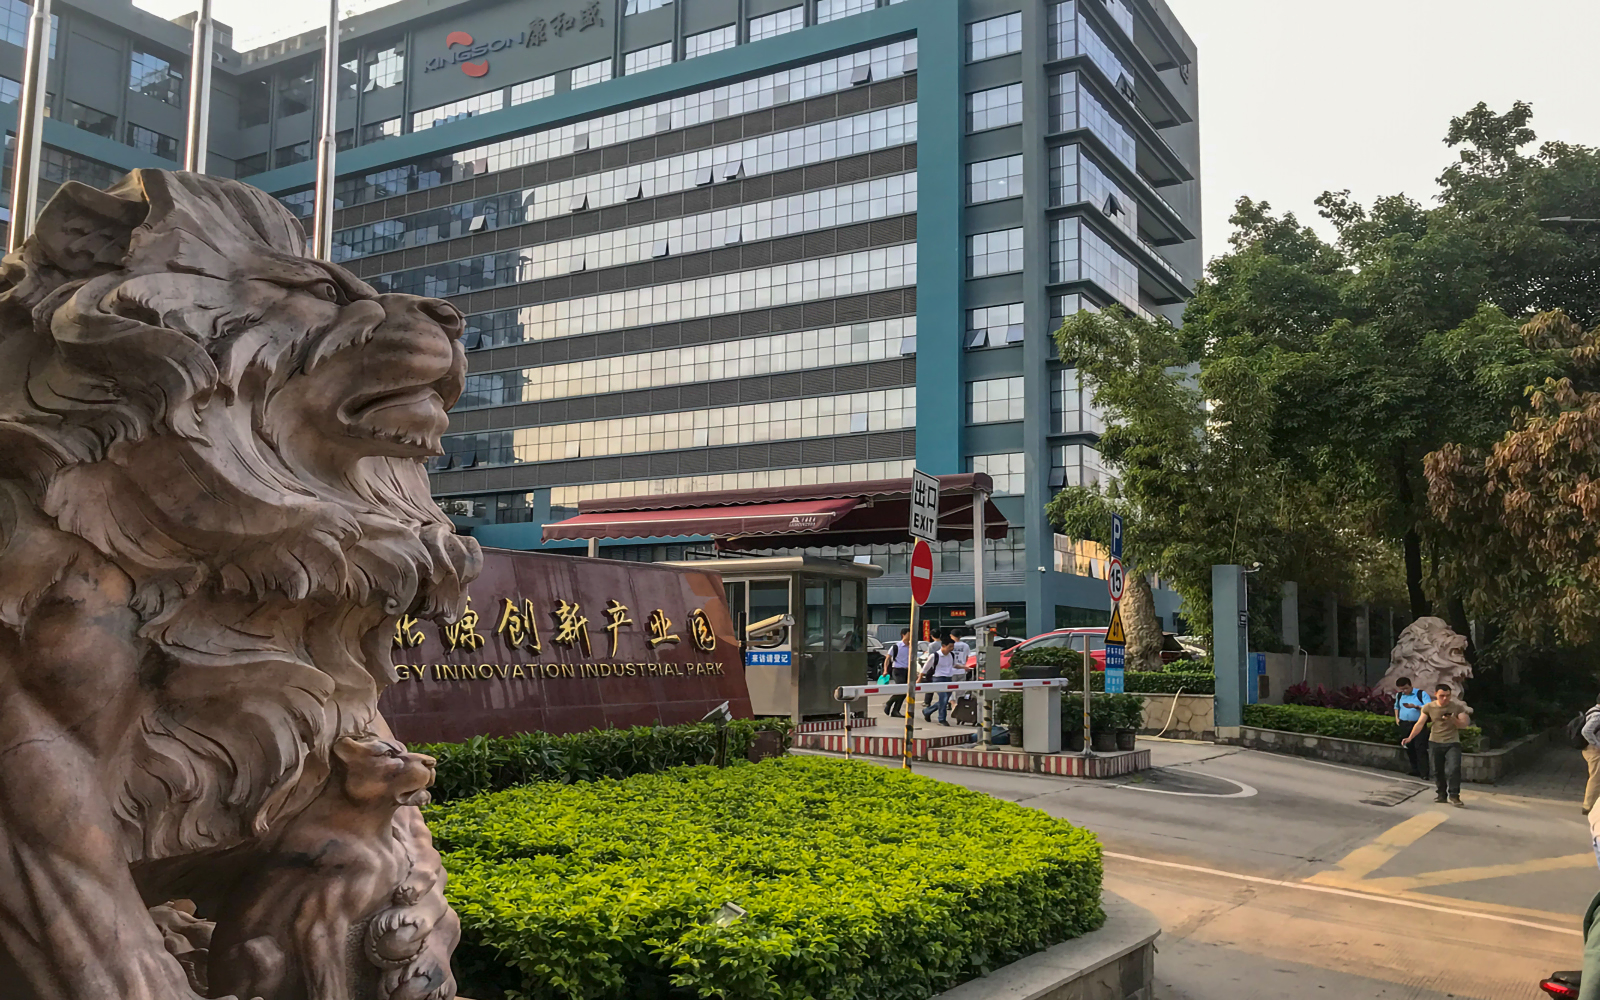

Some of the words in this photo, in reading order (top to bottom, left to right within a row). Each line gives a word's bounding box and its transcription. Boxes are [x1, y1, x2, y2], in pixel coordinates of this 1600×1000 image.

[424, 31, 525, 73] KINGSON
[914, 479, 937, 511] 出口
[913, 512, 935, 534] EXIT
[1113, 517, 1121, 552] P
[1110, 568, 1122, 593] 15
[435, 663, 576, 681] INNOVATION
[579, 662, 684, 678] INDUSTRIAL
[686, 661, 726, 677] PARK
